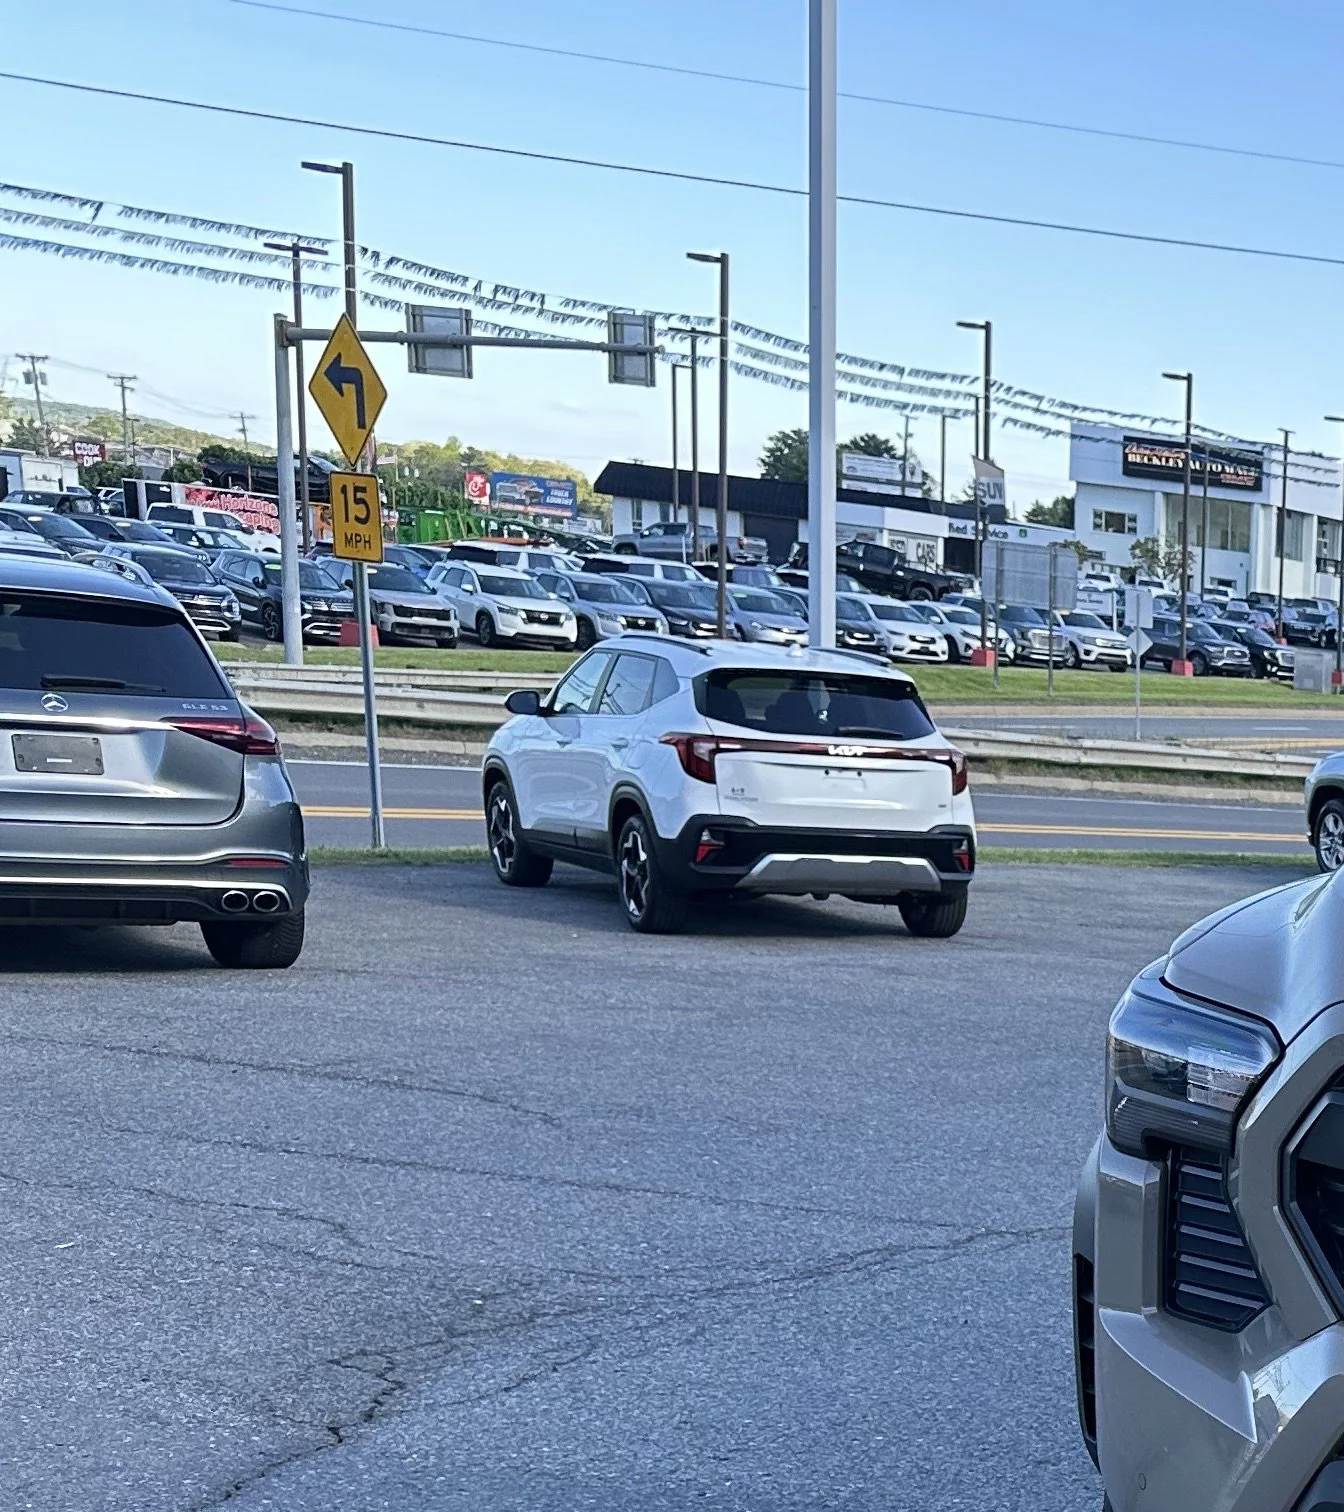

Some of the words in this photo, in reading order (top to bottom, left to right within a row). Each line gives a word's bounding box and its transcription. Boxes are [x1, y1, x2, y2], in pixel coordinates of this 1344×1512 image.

[74, 442, 100, 456] COOK
[1127, 453, 1183, 468] BECKLEY
[340, 483, 371, 525] 15
[344, 532, 372, 551] MPH
